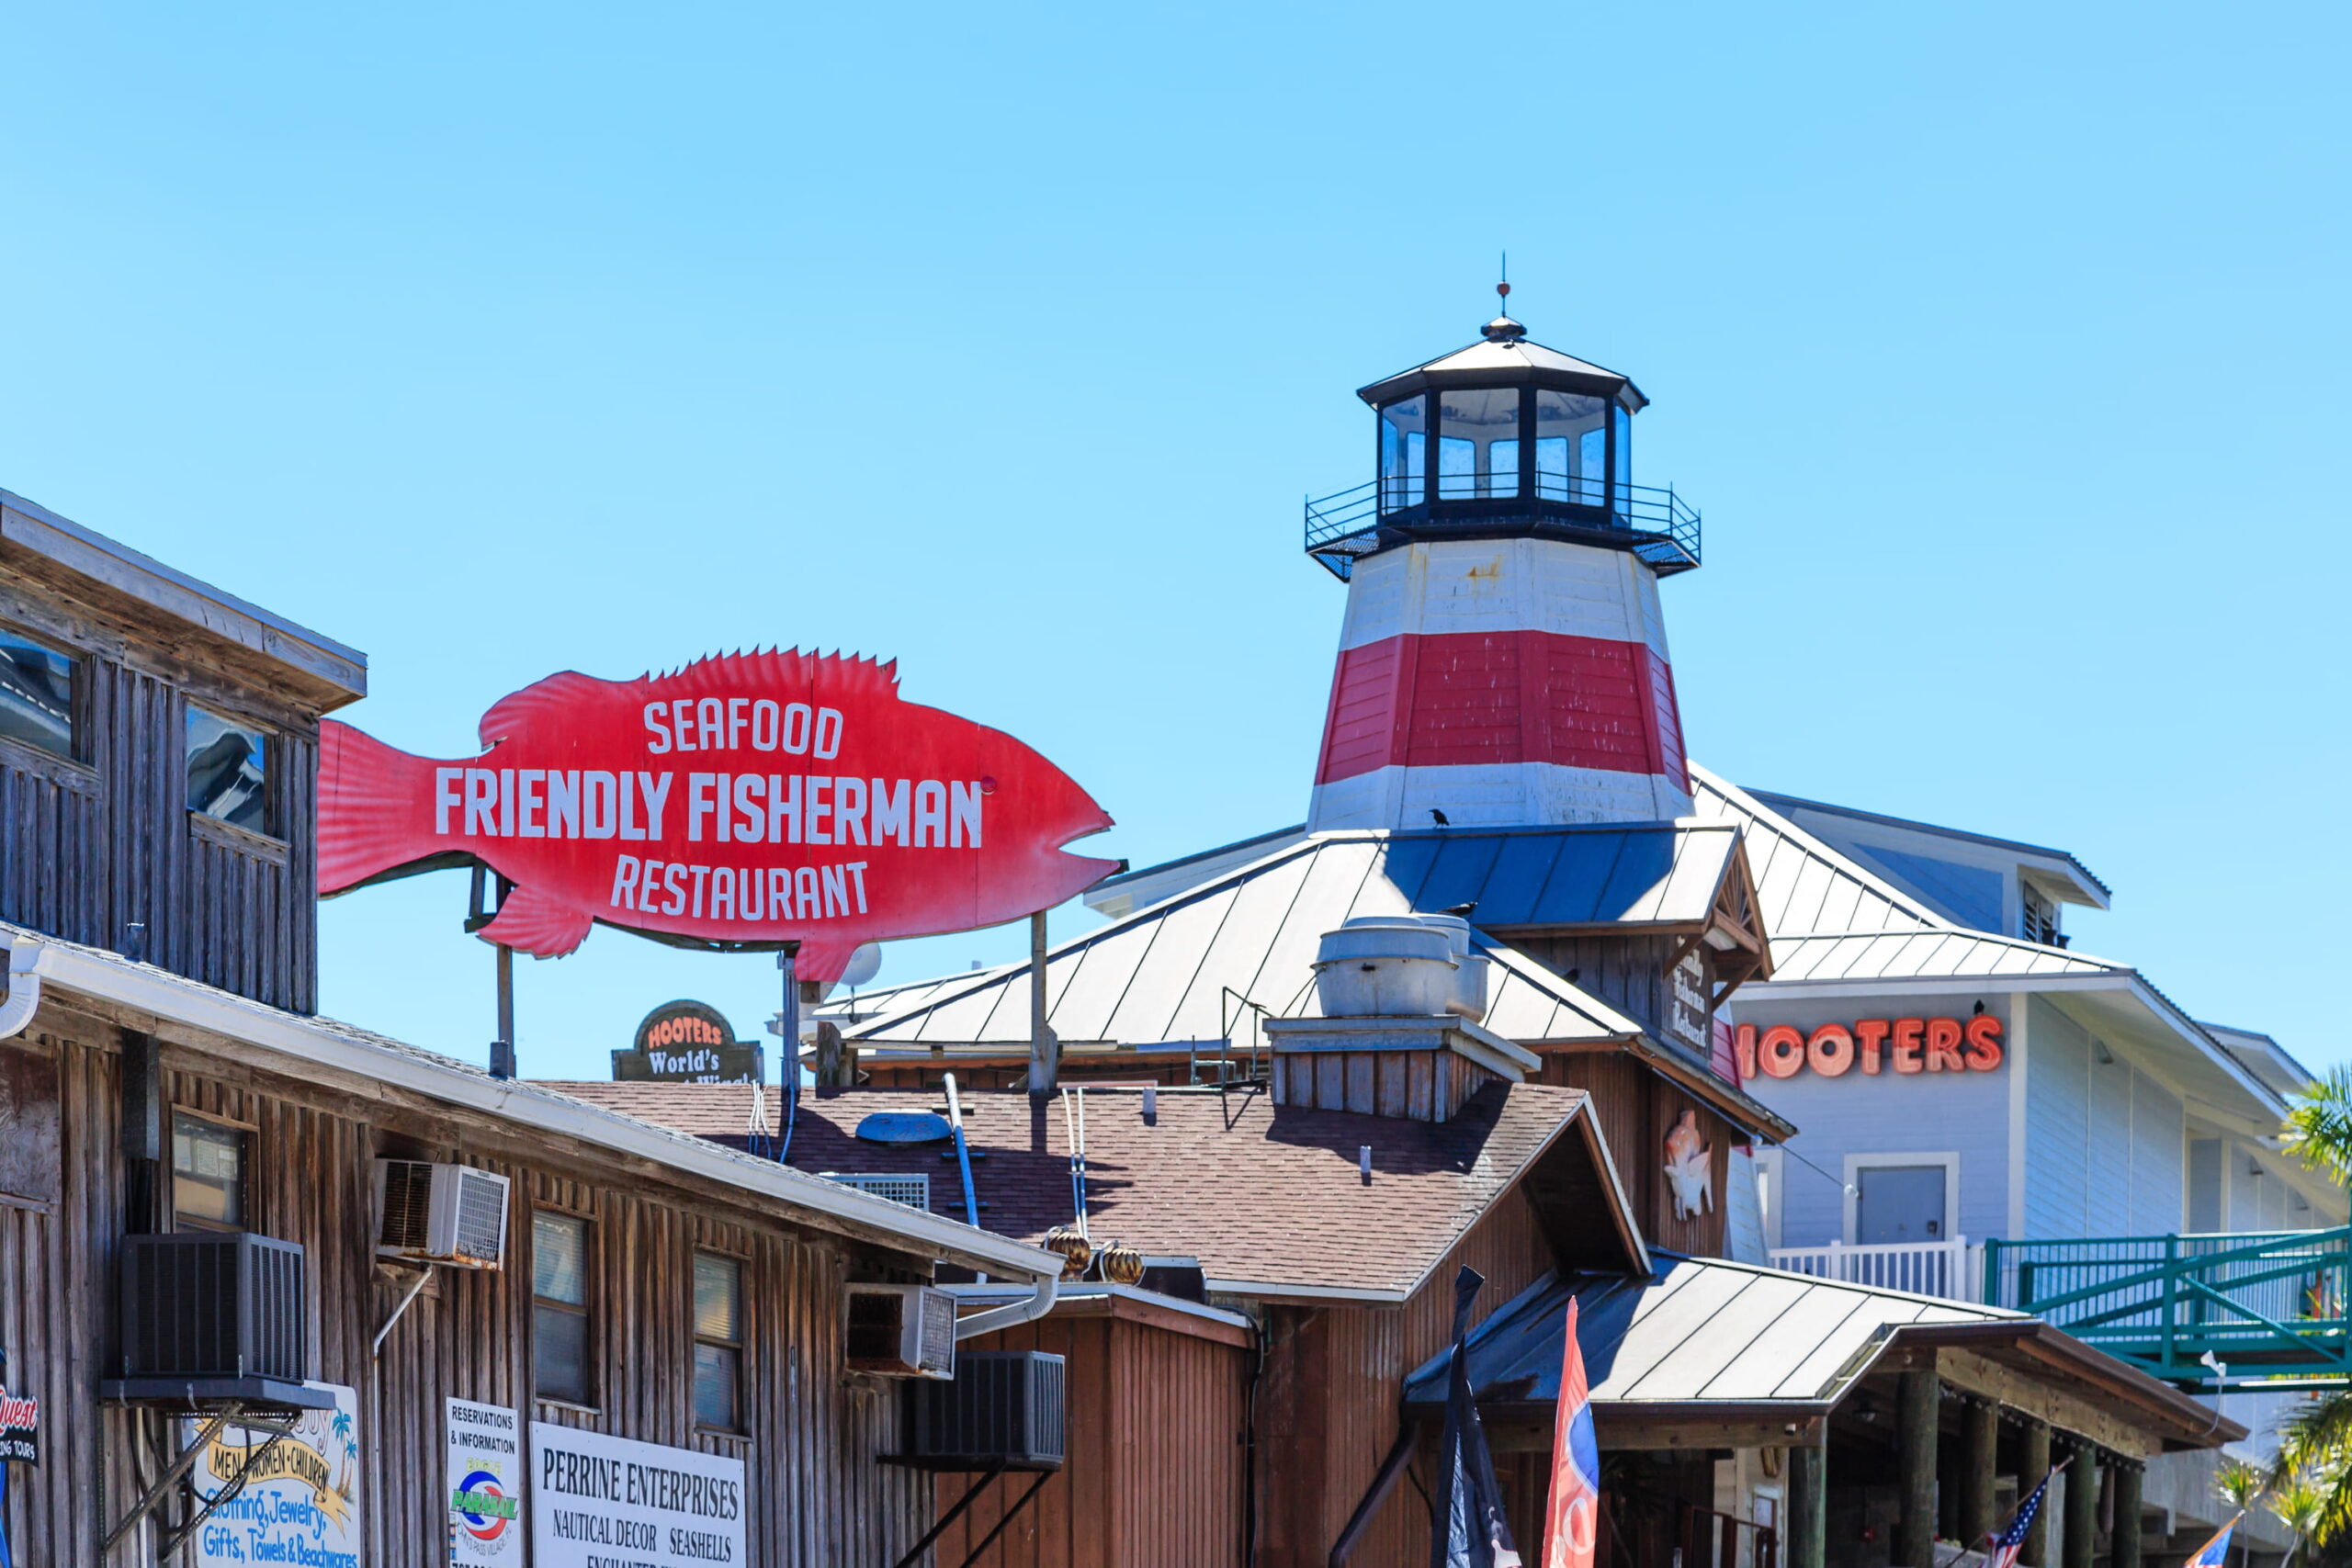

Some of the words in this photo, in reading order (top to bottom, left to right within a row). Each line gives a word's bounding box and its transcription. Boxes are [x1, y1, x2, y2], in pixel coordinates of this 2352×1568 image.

[645, 697, 843, 760] SEAFOOD
[436, 767, 673, 840] FRIENDLY
[688, 773, 982, 848] FISHERMAN
[611, 854, 868, 921] RESTAURANT
[648, 1016, 723, 1049] HOOTERS
[649, 1049, 719, 1075] World's
[452, 1405, 513, 1430] RESERVATIONS
[14, 1439, 35, 1461] TOURS
[451, 1430, 457, 1445] &
[459, 1432, 515, 1455] INFORMATION
[214, 1446, 242, 1480] MEN
[291, 1447, 329, 1495] CHILDREN
[543, 1448, 621, 1503] PERRINE
[627, 1462, 738, 1522] ENTERPRISES
[269, 1491, 327, 1540] Jewelry,
[450, 1489, 517, 1521] PARASAIL
[203, 1525, 245, 1564] Gifts,
[247, 1529, 286, 1562] Towels
[288, 1537, 296, 1562] &
[298, 1533, 357, 1568] Beachwares
[553, 1509, 613, 1545] NAUTICAL
[616, 1519, 657, 1552] DECOR
[669, 1528, 732, 1563] SEASHELLS
